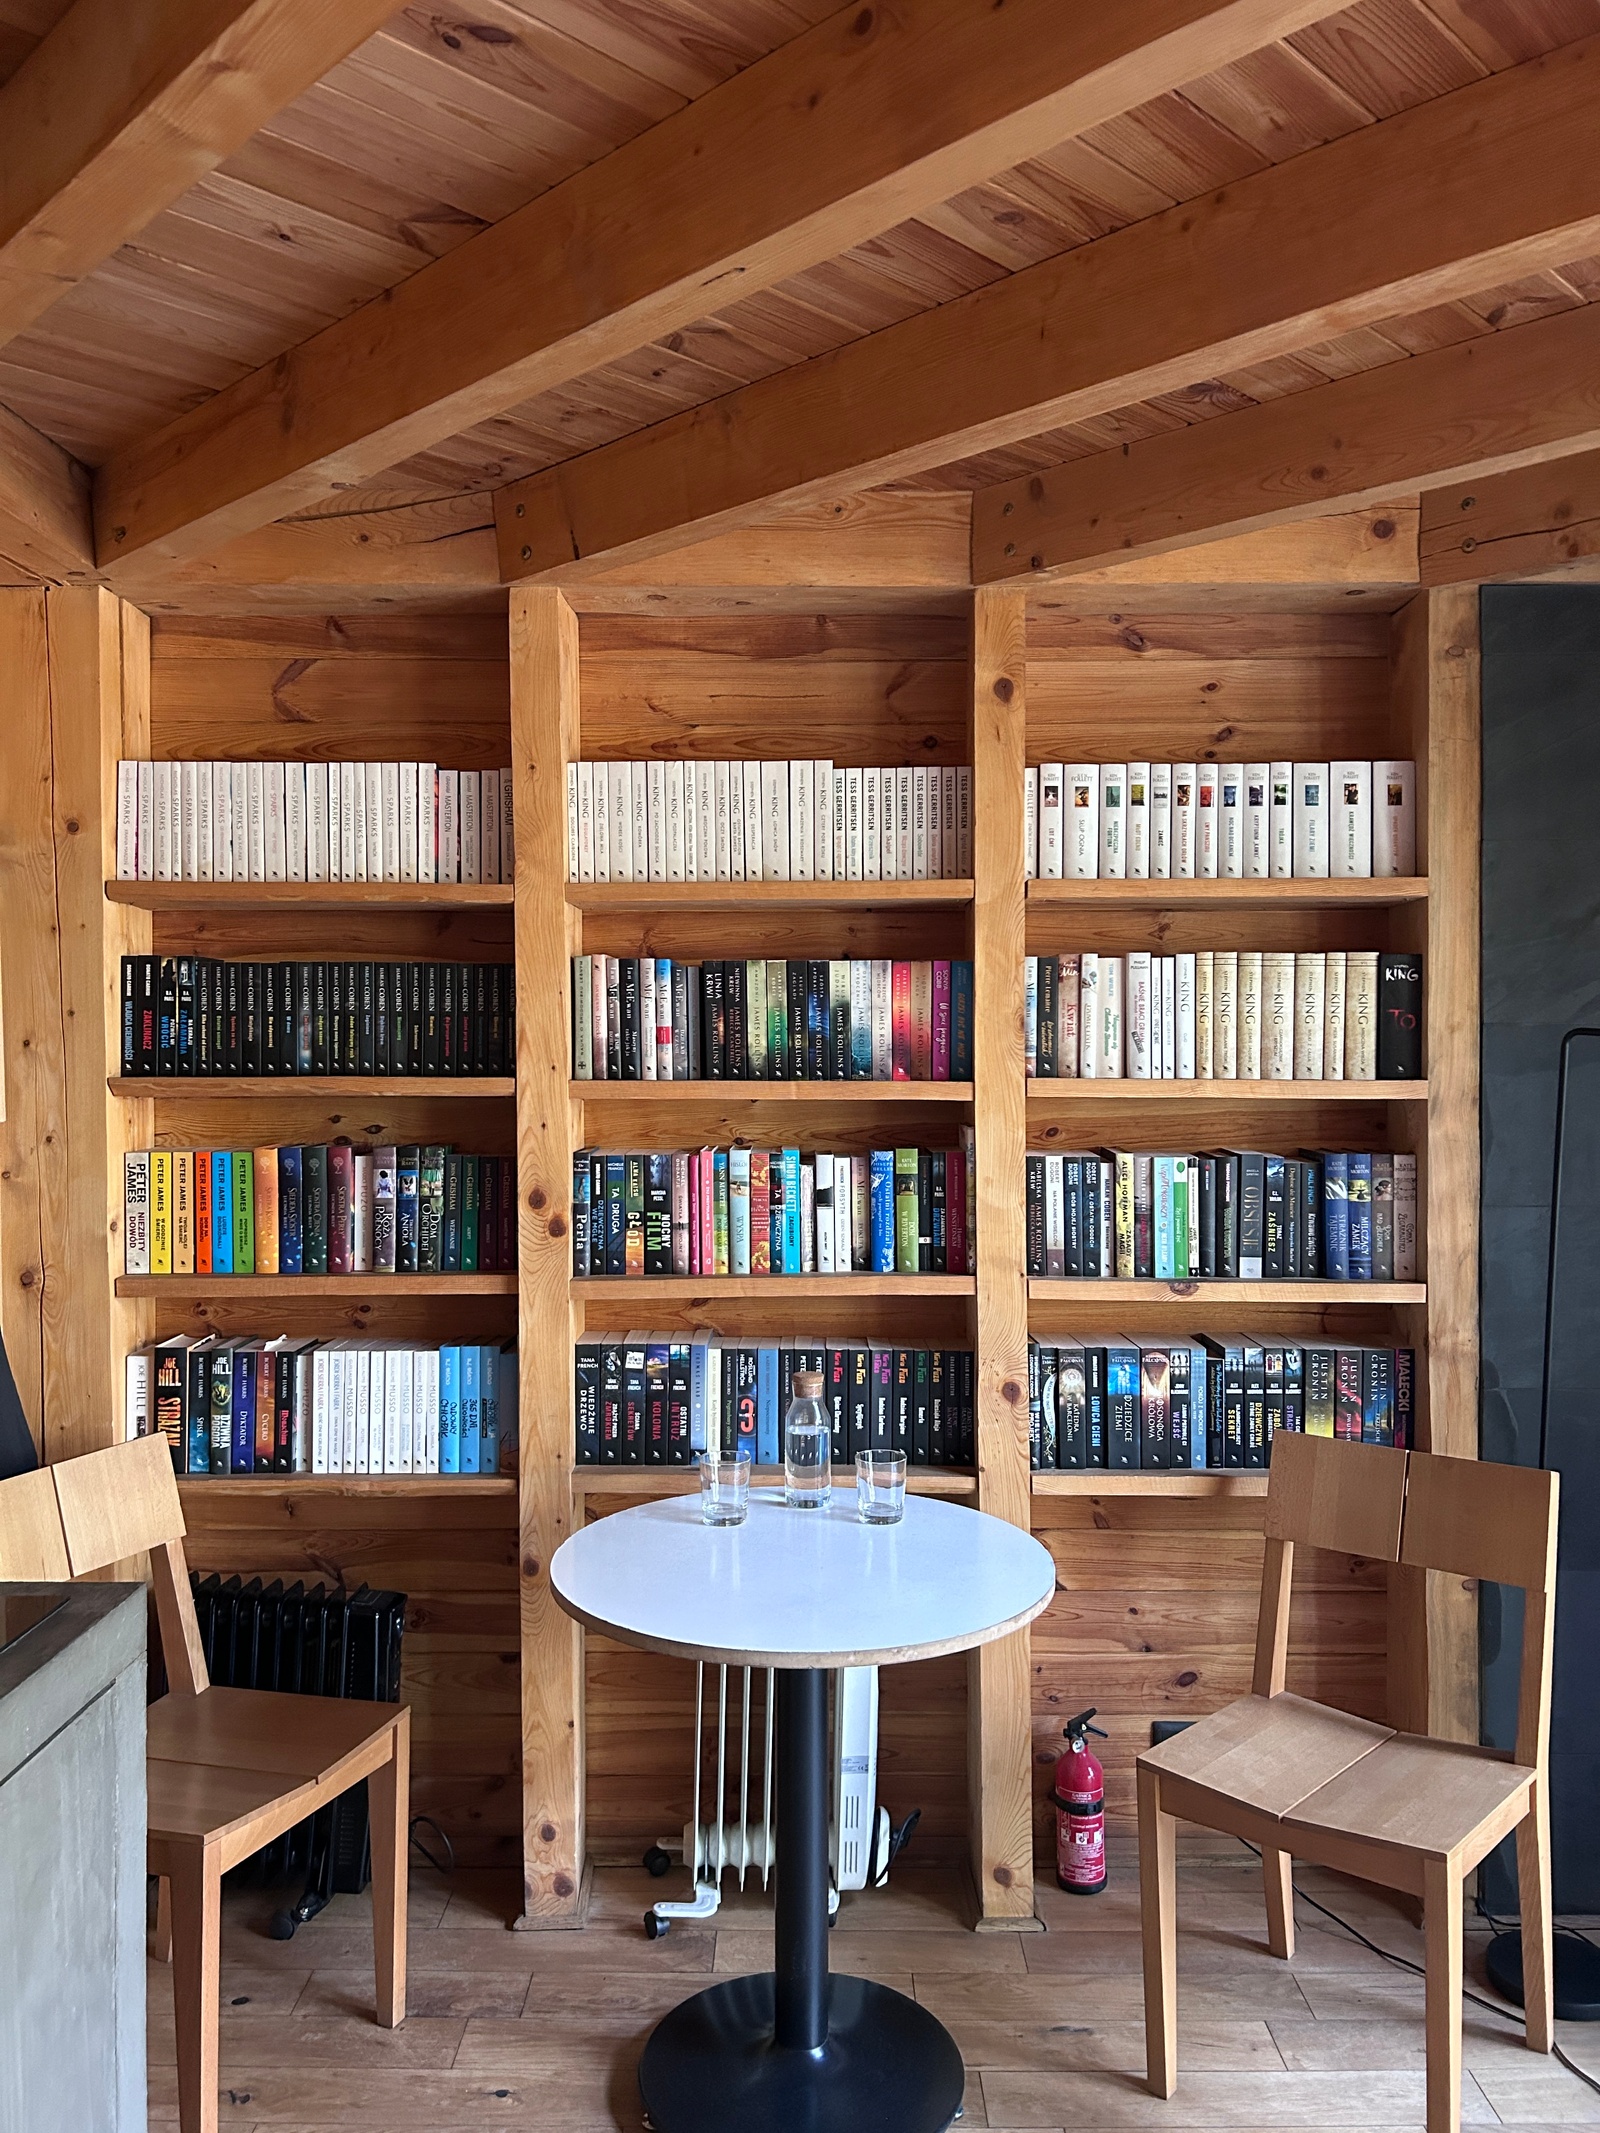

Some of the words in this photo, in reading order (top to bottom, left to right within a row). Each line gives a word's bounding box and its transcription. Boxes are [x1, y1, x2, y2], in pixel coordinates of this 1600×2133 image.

[504, 785, 513, 826] GRISHAM
[706, 974, 714, 999] KRWI
[715, 973, 723, 999] LINIA
[1138, 981, 1146, 1001] BAŚNIE
[1385, 968, 1419, 982] KING
[125, 1001, 133, 1025] WŁADCA
[626, 983, 635, 1019] McEwan
[659, 984, 668, 1020] McEwan
[675, 983, 684, 1017] McEwan
[1220, 992, 1231, 1023] KING
[1273, 994, 1284, 1025] KING
[1305, 993, 1315, 1024] KING
[1330, 993, 1340, 1024] KING
[1358, 993, 1368, 1025] KING
[143, 1010, 152, 1049] ZAKLINACZ
[161, 1016, 170, 1048] WRÓCIĆ
[1067, 1003, 1077, 1037] Kwiat
[125, 1027, 134, 1060] CIEMNOŚCI
[127, 1163, 136, 1203] JAMES
[137, 1163, 146, 1203] PETER
[786, 1156, 796, 1179] SIMON
[612, 1187, 619, 1198] TA
[775, 1189, 781, 1199] TA
[786, 1181, 796, 1212] BECKETT
[375, 1206, 384, 1251] PÓŁNOCY
[381, 1213, 394, 1238] RÓŻA
[401, 1213, 410, 1246] ANIOŁA
[421, 1204, 432, 1251] ORCHIDEI
[430, 1213, 440, 1238] DOM
[592, 1208, 597, 1220] WE
[628, 1212, 642, 1247] GŁÓD
[736, 1215, 744, 1244] WYSPA
[908, 1221, 916, 1236] DOM
[1242, 1186, 1260, 1251] OBSESJE
[129, 1216, 137, 1248] DOWÓD
[576, 1214, 587, 1250] Perła
[647, 1212, 661, 1251] FILM
[661, 1214, 671, 1248] NOCNY
[901, 1218, 909, 1247] RIVERTON
[1268, 1211, 1277, 1253] ZAŚNIESZ
[1328, 1215, 1338, 1252] TAJEMNIC
[1339, 1214, 1347, 1252] STRAŻNIK
[1352, 1223, 1360, 1250] ZAMEK
[1360, 1216, 1369, 1255] MILCZĄCY
[158, 1369, 181, 1386] HILL
[163, 1358, 177, 1369] JOE
[212, 1364, 232, 1374] HILL
[1379, 1357, 1387, 1400] JUSTIN
[136, 1380, 146, 1410] HILL
[1349, 1359, 1357, 1402] JUSTIN
[1398, 1354, 1410, 1411] MAŁECKI
[469, 1399, 477, 1412] 365
[588, 1386, 596, 1434] WIEDŹMIE
[627, 1401, 635, 1441] SEKRETÓW
[652, 1401, 661, 1440] KOLONIA
[671, 1402, 680, 1441] INTRUZ
[1091, 1396, 1100, 1423] ŁOWCA
[196, 1417, 204, 1437] SPISEK
[212, 1414, 220, 1448] POGODA
[220, 1414, 230, 1448] DZIWNA
[239, 1411, 247, 1446] DYKTATOR
[261, 1414, 270, 1441] CYCERO
[1092, 1425, 1100, 1447] CIENI
[1172, 1411, 1182, 1439] WEJŚĆ
[1228, 1409, 1236, 1440] SEKRET
